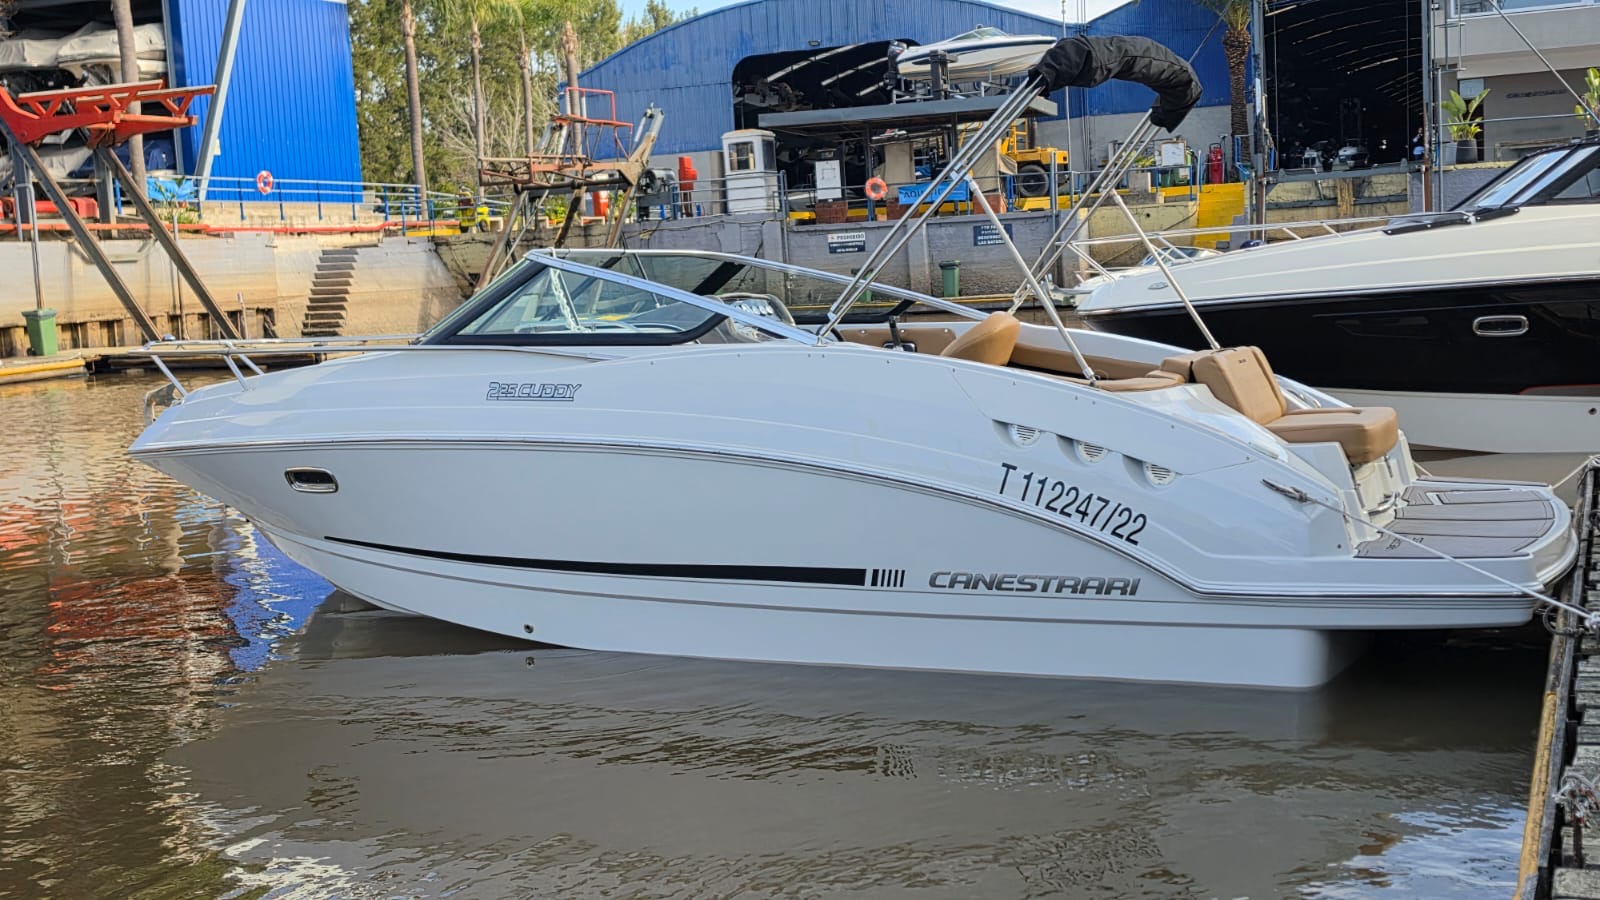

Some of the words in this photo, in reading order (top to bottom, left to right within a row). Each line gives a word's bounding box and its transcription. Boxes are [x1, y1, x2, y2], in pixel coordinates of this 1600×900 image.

[518, 383, 582, 399] CUDDY
[999, 462, 1018, 495] T
[1021, 471, 1148, 545] 112247/22
[928, 571, 1141, 596] CANESTRARI
